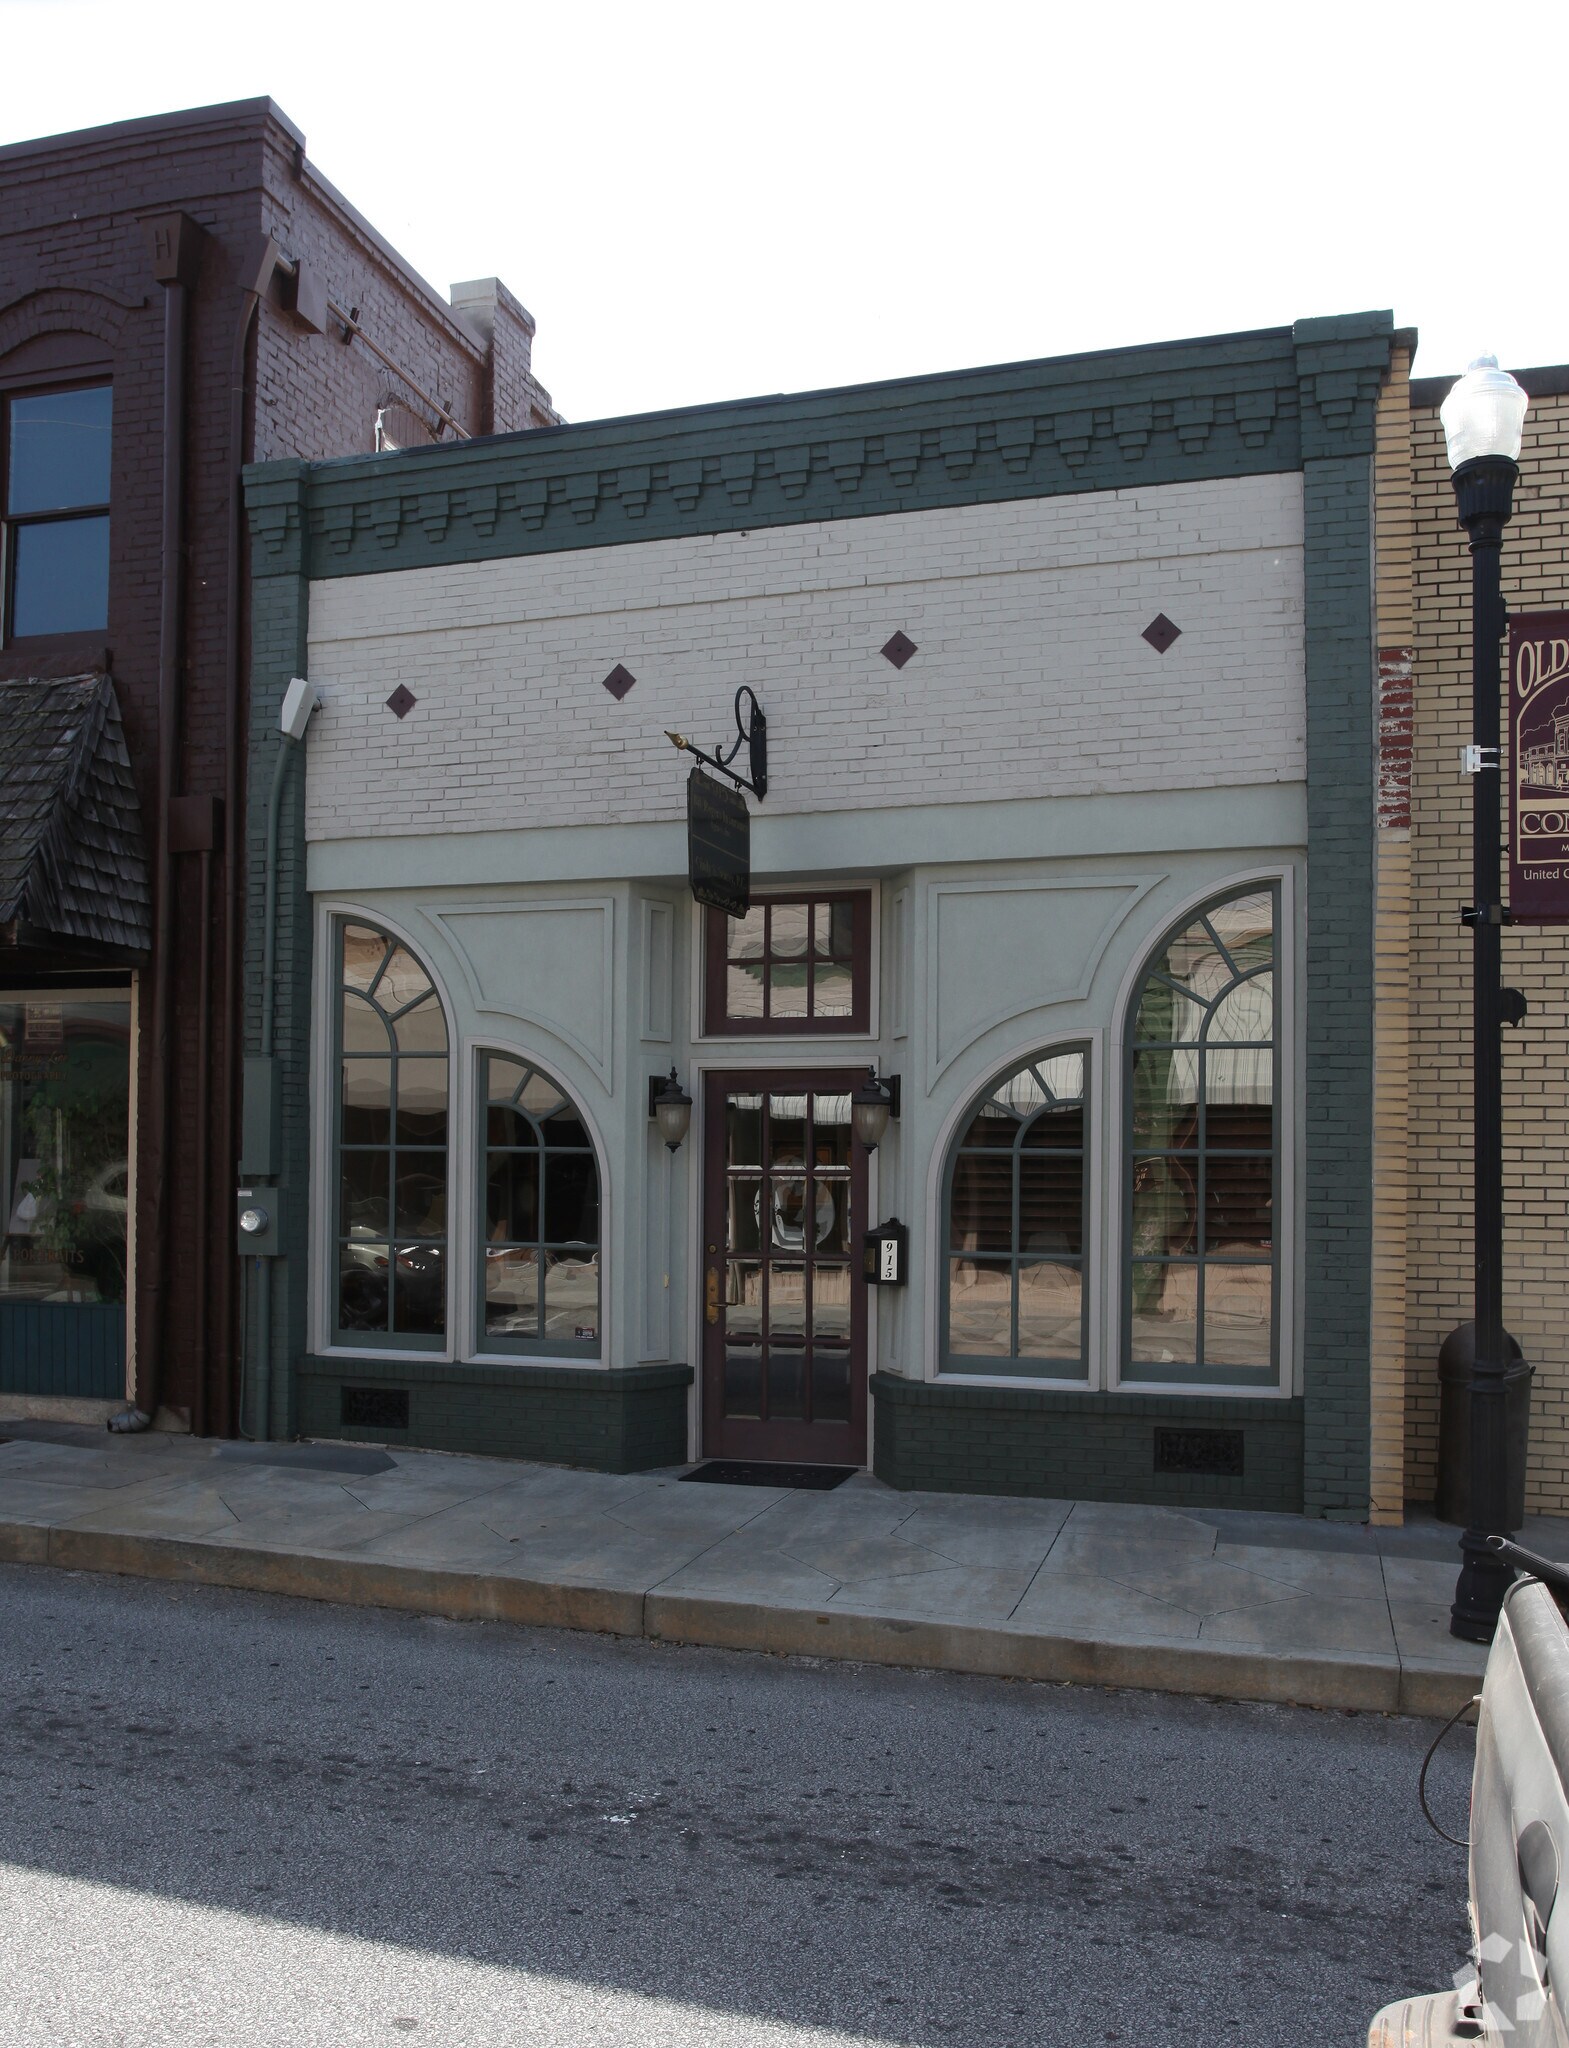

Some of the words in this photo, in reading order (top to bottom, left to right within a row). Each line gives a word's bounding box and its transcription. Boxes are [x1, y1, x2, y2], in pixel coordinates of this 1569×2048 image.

[1517, 639, 1569, 698] OLD
[1523, 868, 1560, 880] United
[885, 1241, 893, 1279] 915
